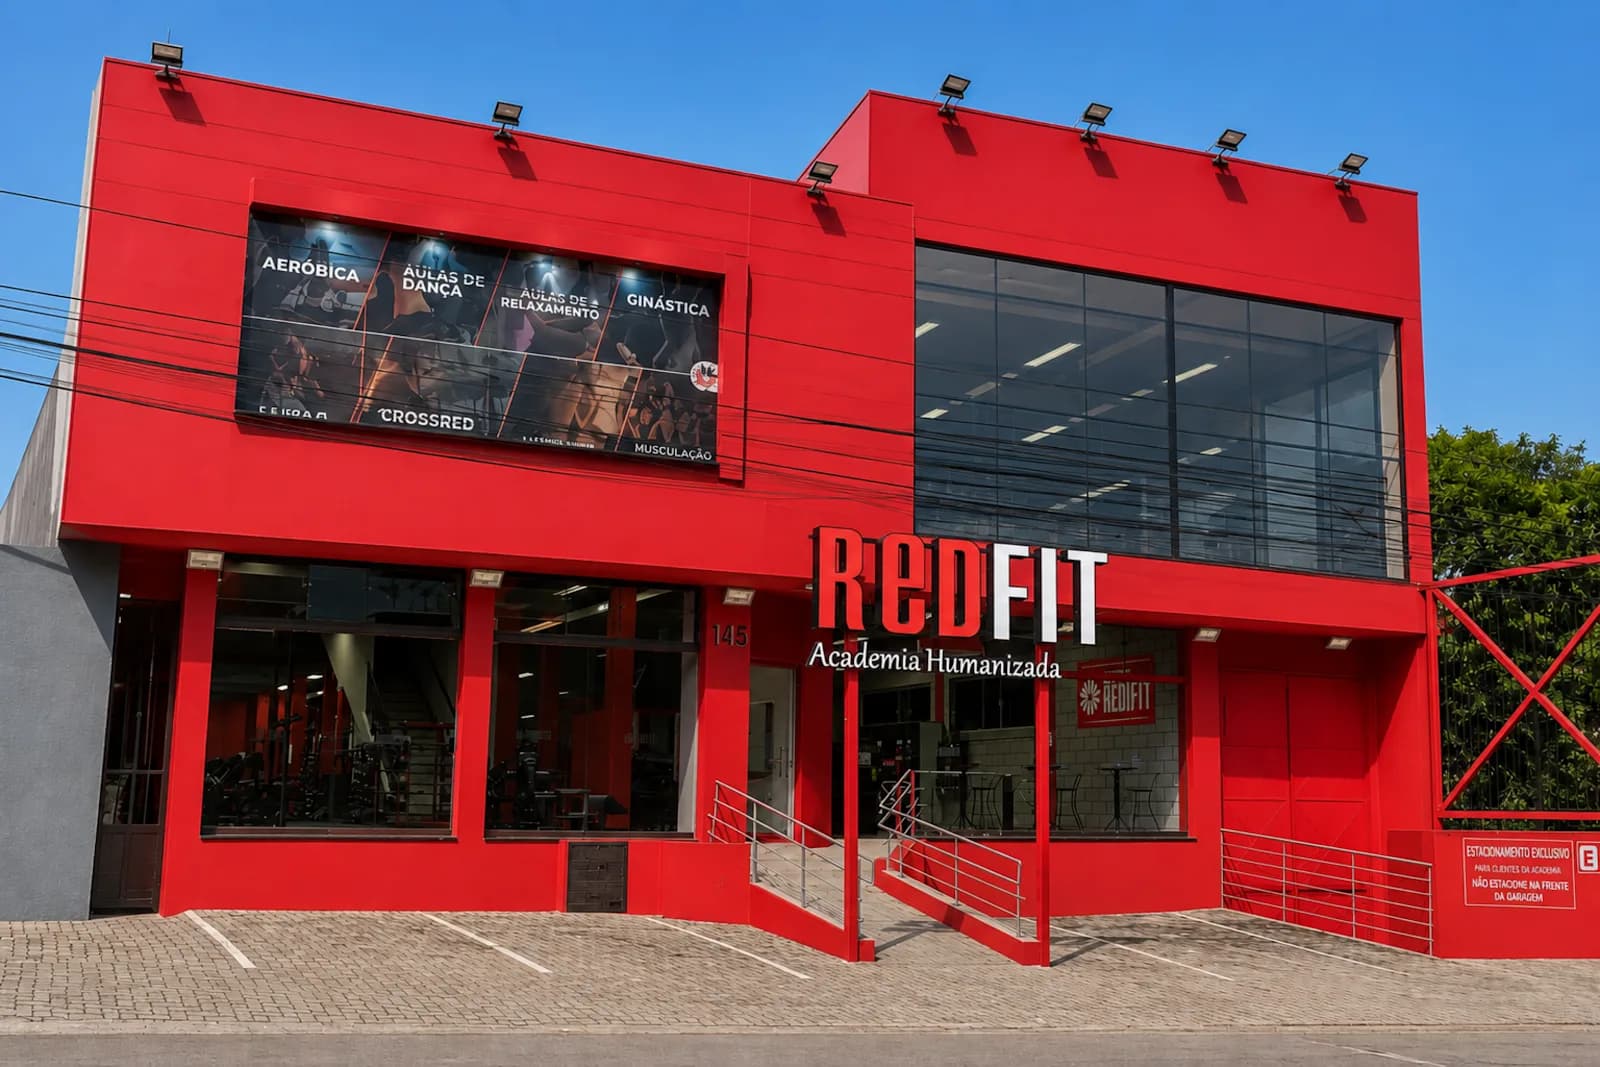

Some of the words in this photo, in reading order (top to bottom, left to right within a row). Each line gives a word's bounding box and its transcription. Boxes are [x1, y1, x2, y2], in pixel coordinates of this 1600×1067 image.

[262, 256, 360, 283] AERÓBICA
[403, 264, 458, 284] AULAS
[463, 273, 485, 288] DE
[403, 277, 463, 299] DANÇA
[520, 287, 566, 304] AULAS
[569, 294, 589, 307] DE
[501, 296, 600, 320] RELAXAMENTO
[626, 293, 710, 318] GINÁSTICA
[379, 407, 475, 431] CROSSRED
[634, 443, 712, 461] MUSCULAÇÃO
[712, 623, 749, 648] 145
[808, 641, 921, 671] Academia
[927, 647, 1062, 679] Humanizada
[1467, 845, 1529, 859] ESTACIONAMENTO
[1532, 847, 1570, 859] EXCLUSIVO
[1474, 864, 1490, 873] PARA
[1492, 865, 1520, 873] CLIENTES
[1472, 876, 1488, 888] NÃO
[1490, 879, 1527, 890] ESTACIONE
[1529, 881, 1541, 890] NA
[1542, 881, 1569, 891] FRENTE
[1494, 892, 1505, 901] DA
[1507, 893, 1543, 902] GARAGEM
